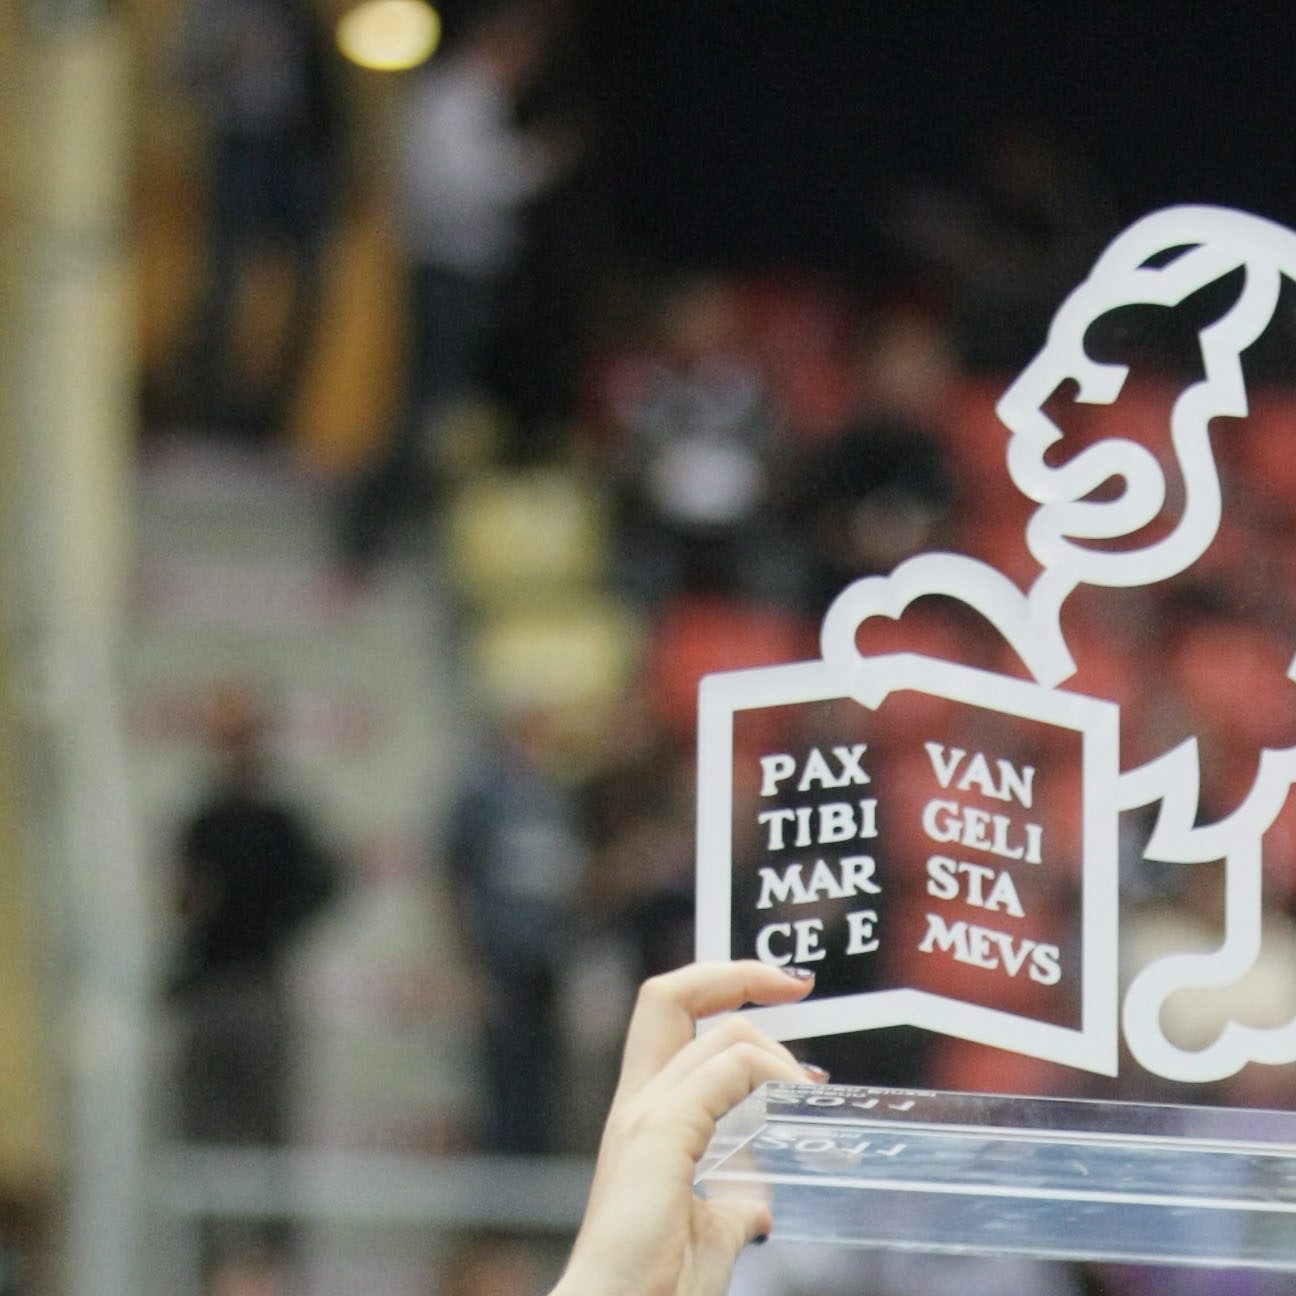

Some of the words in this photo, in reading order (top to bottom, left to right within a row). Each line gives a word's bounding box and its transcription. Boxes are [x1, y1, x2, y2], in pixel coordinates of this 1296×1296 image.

[760, 743, 871, 797] PAX
[924, 741, 1035, 808] VAN
[758, 799, 878, 851] TIBI
[922, 799, 1042, 864] GELI
[756, 855, 881, 909] MAR
[927, 855, 1025, 917] STA
[755, 918, 826, 968] CE
[846, 910, 879, 955] E
[919, 914, 1062, 985] MEVS
